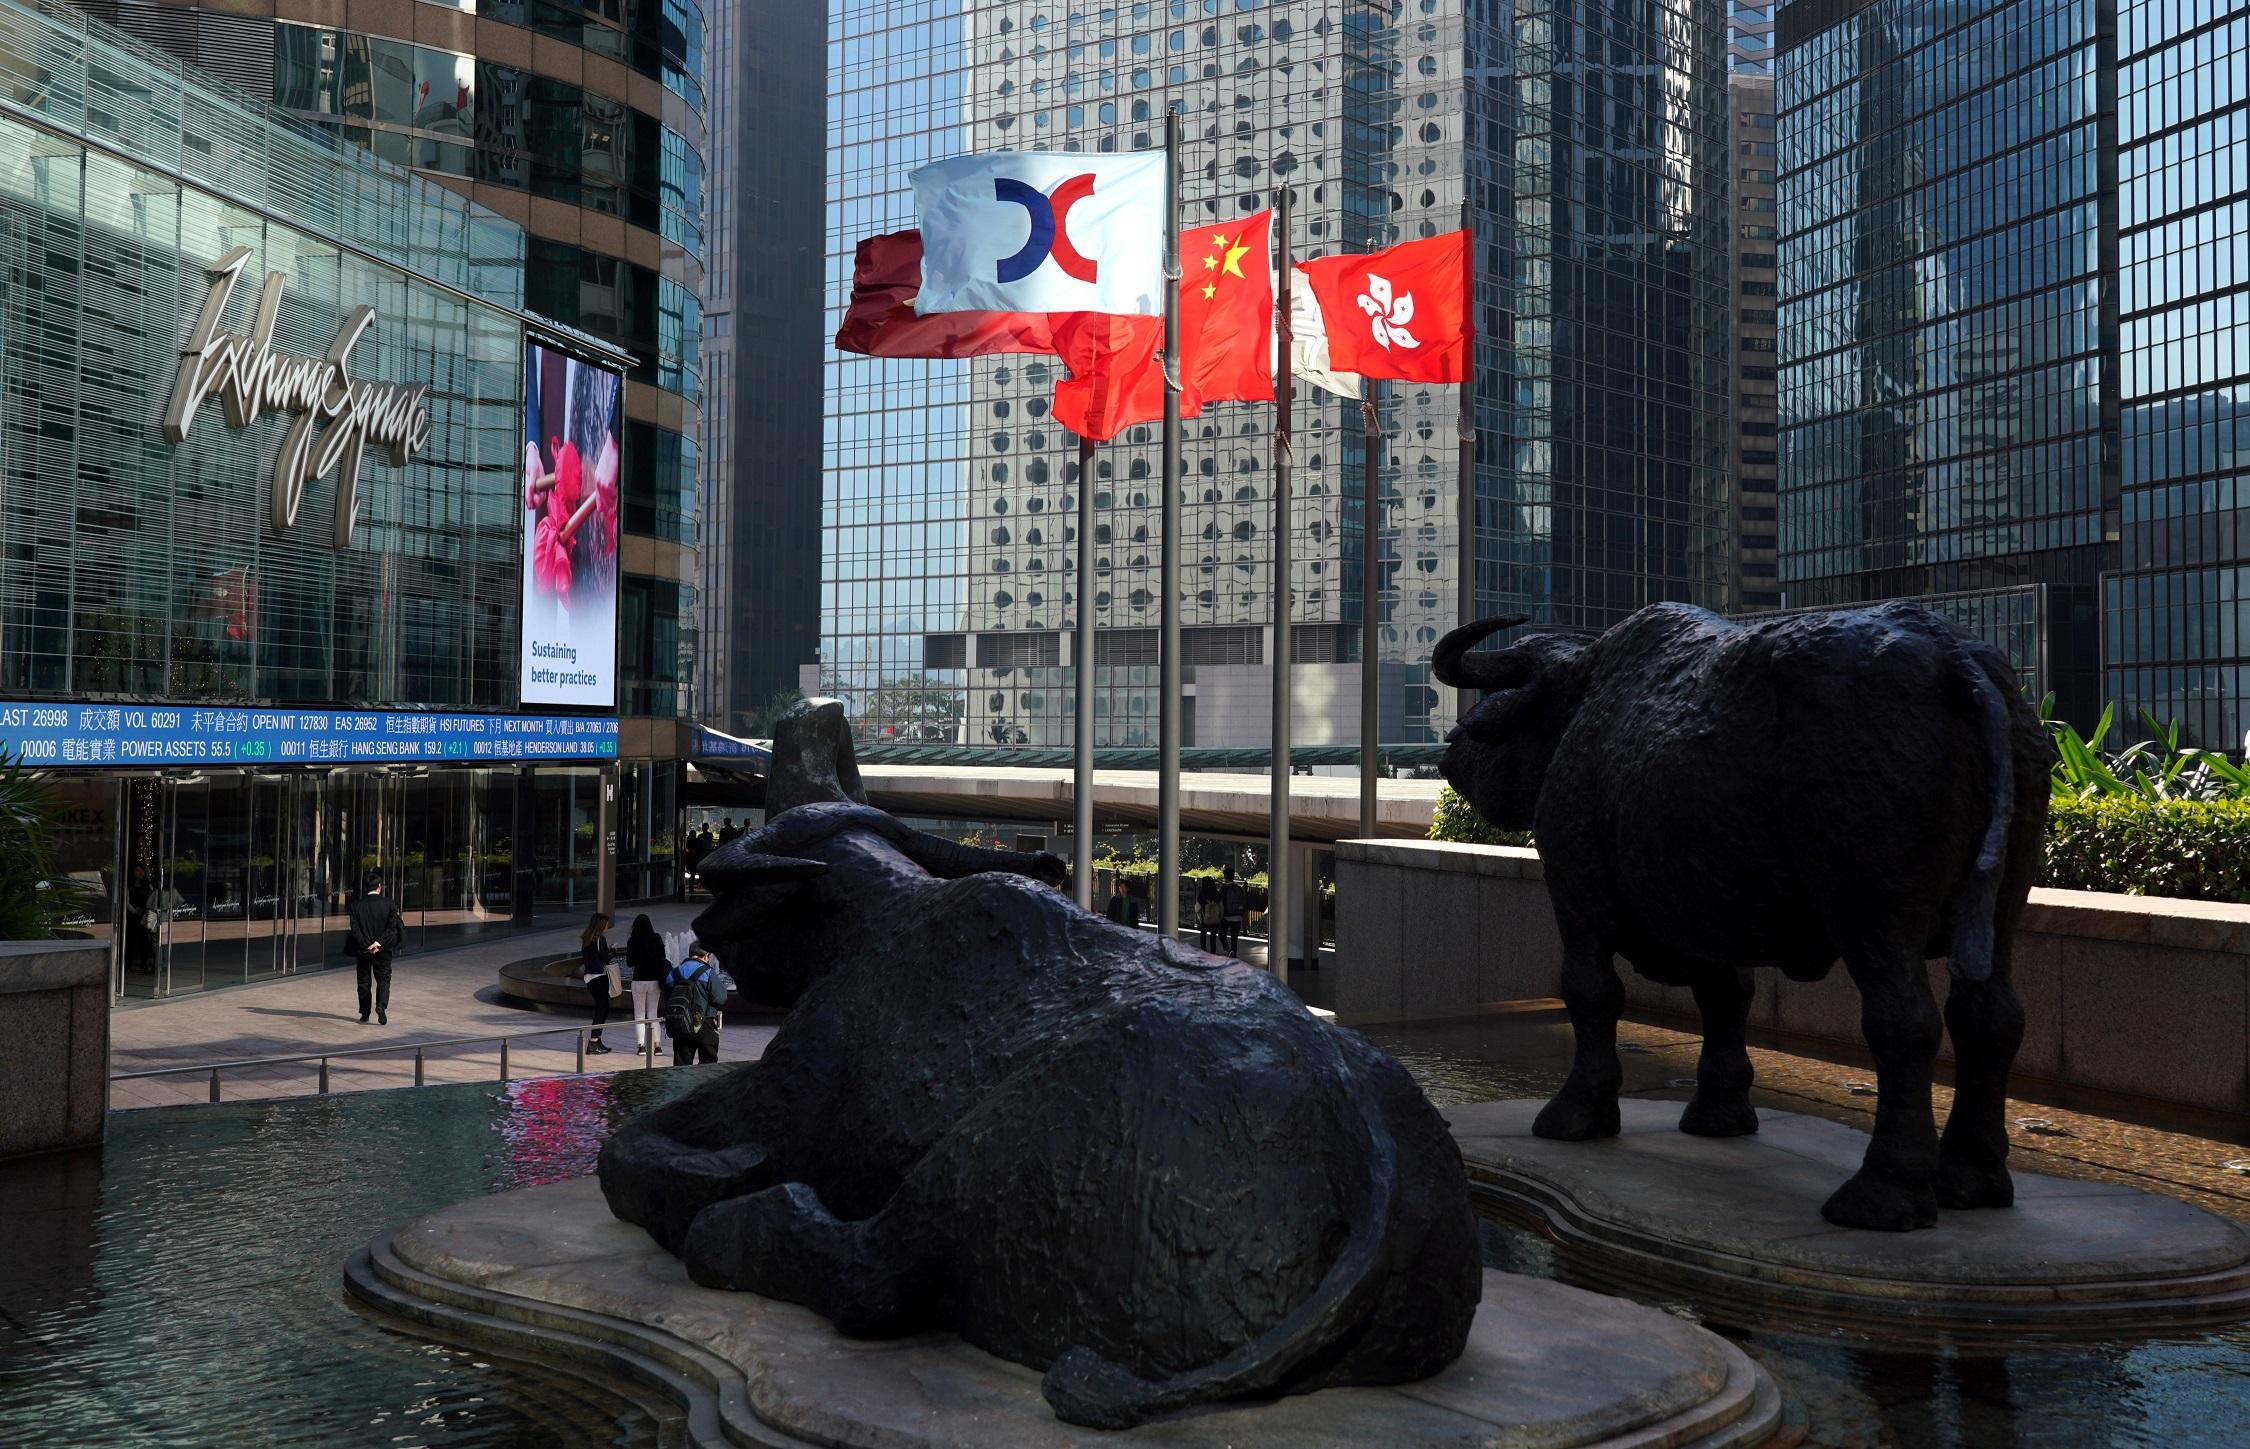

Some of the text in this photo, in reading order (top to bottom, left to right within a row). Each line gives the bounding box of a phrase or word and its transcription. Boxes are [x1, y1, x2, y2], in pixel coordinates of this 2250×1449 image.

[532, 640, 576, 664] Sustaining
[531, 666, 597, 688] better practices
[33, 709, 68, 727] 26998
[79, 708, 120, 731] 成交額
[125, 711, 147, 728] VOL
[151, 712, 180, 728] 60291
[191, 711, 248, 732] 未平倉合約
[252, 714, 279, 729] OPEN
[281, 715, 295, 730] INT
[300, 716, 328, 730] 127830
[336, 717, 352, 731] EAS
[354, 717, 377, 731] 26952
[440, 719, 451, 732] HSI
[453, 719, 485, 732] FUTURES
[488, 718, 501, 735] 下月
[503, 720, 520, 732] NEXT
[521, 720, 544, 733] MONTH
[21, 740, 56, 758] 00006
[62, 738, 116, 761] 電能實業
[121, 741, 162, 757] POWER
[165, 741, 206, 757] ASSETS
[211, 741, 231, 756] 55.5
[281, 741, 305, 756] 00011
[309, 739, 348, 758] 恒生銀行
[351, 741, 375, 755] HANG
[376, 741, 398, 755] SENG
[399, 741, 420, 755] BANK
[424, 741, 442, 754] 159.2
[473, 741, 492, 754] 00012
[524, 741, 562, 753] HENDERSON
[563, 741, 578, 753] LAND
